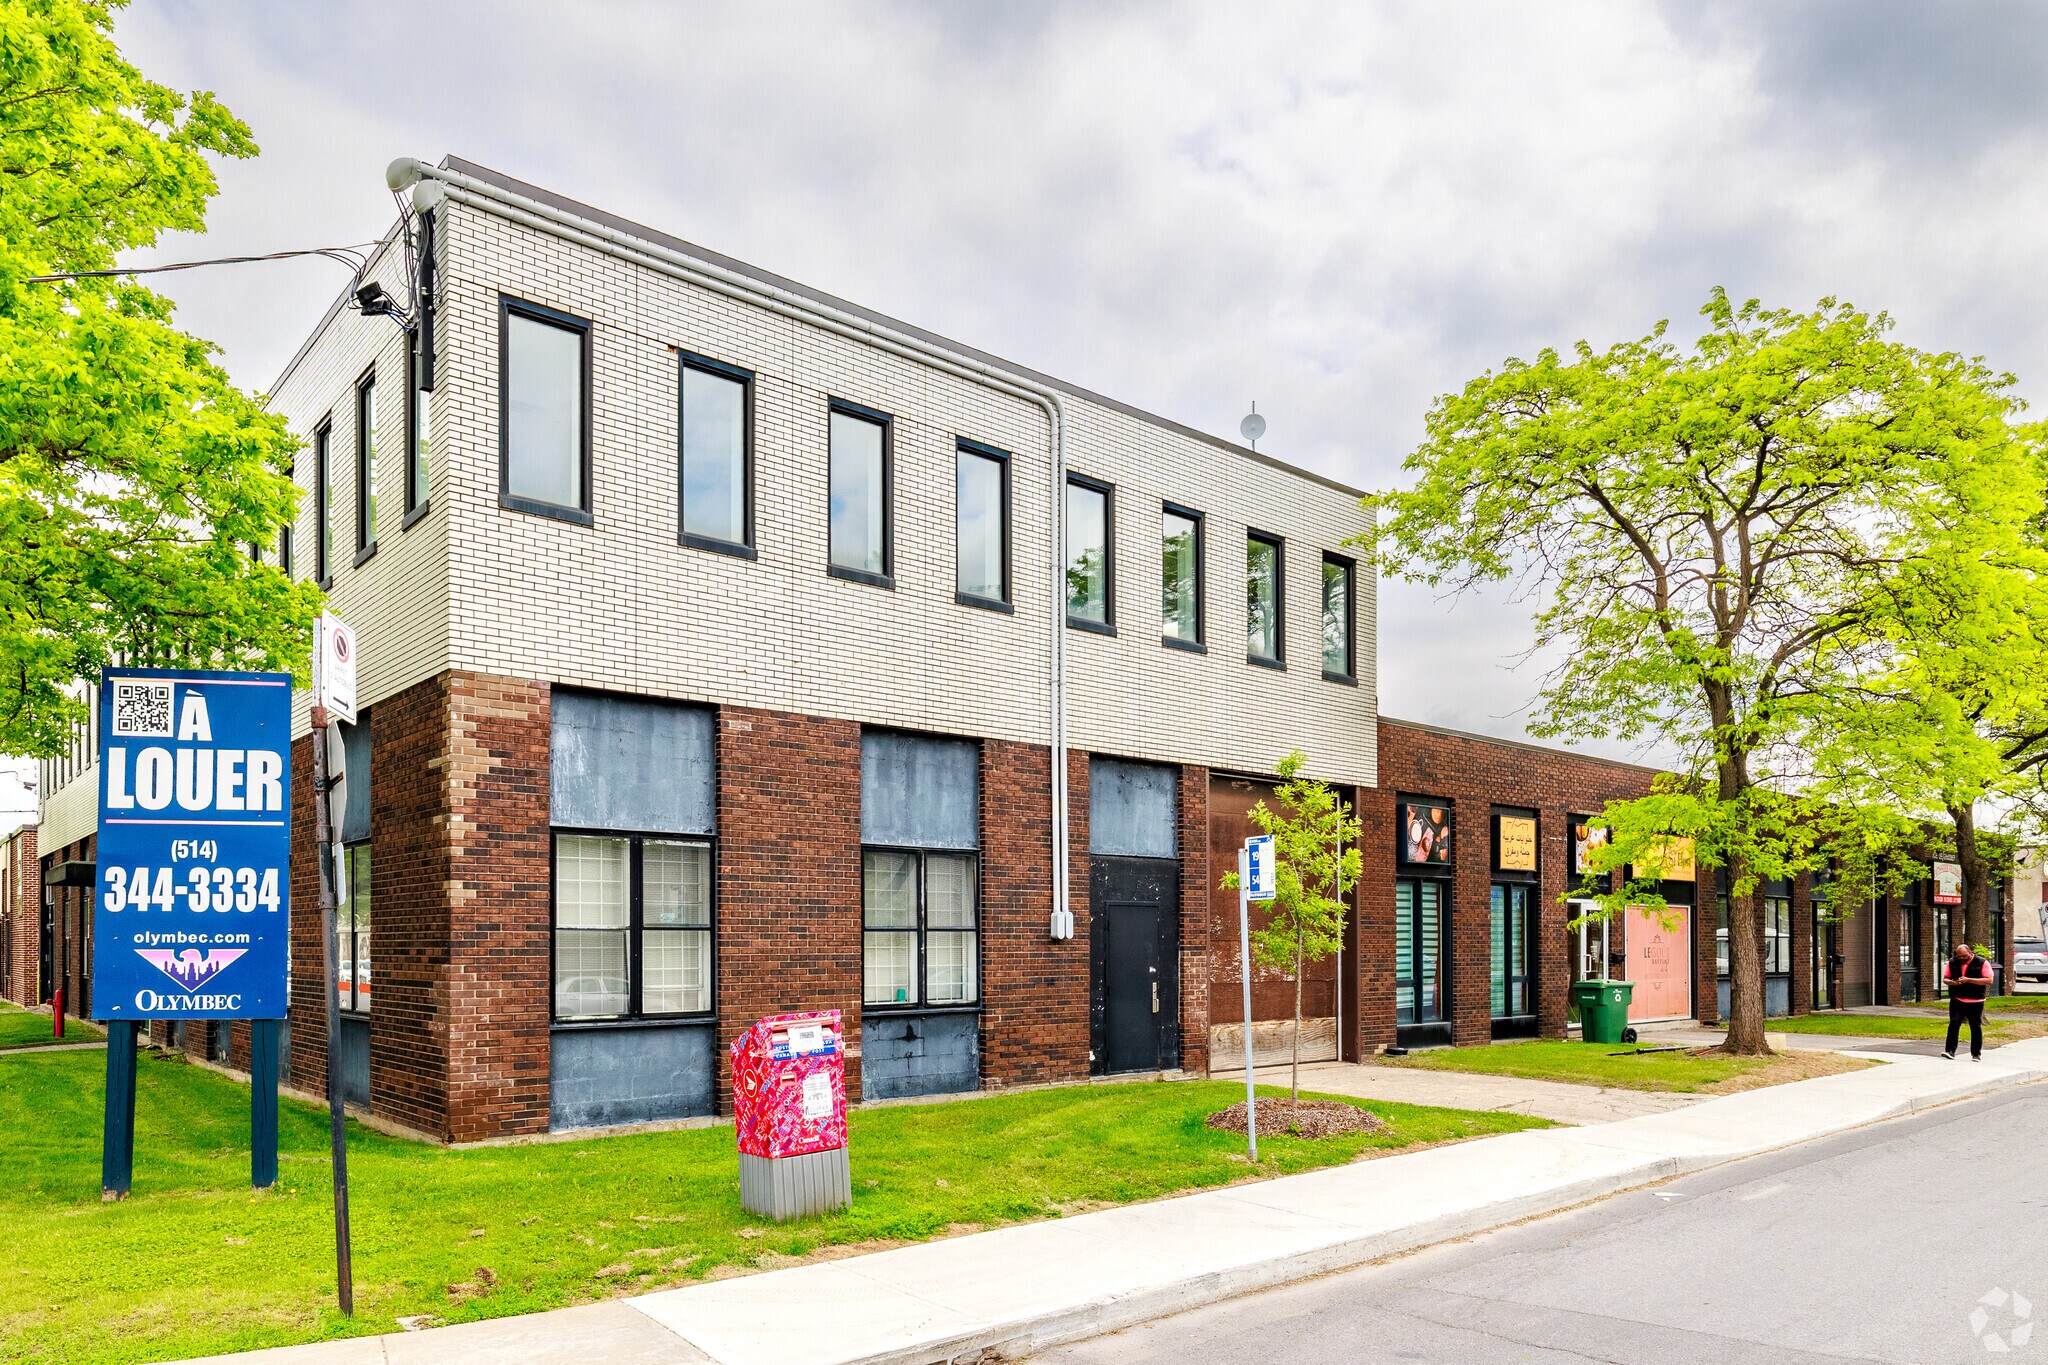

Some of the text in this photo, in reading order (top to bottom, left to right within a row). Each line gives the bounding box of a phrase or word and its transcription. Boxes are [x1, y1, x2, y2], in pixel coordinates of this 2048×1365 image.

[177, 688, 213, 742] À
[106, 746, 283, 812] LOUER
[171, 839, 218, 863] (514)
[1251, 851, 1260, 862] 19
[104, 866, 281, 913] 344-3334
[1251, 874, 1260, 885] 54
[133, 930, 250, 946] olymbec.com
[134, 989, 242, 1012] OLYMBEC
